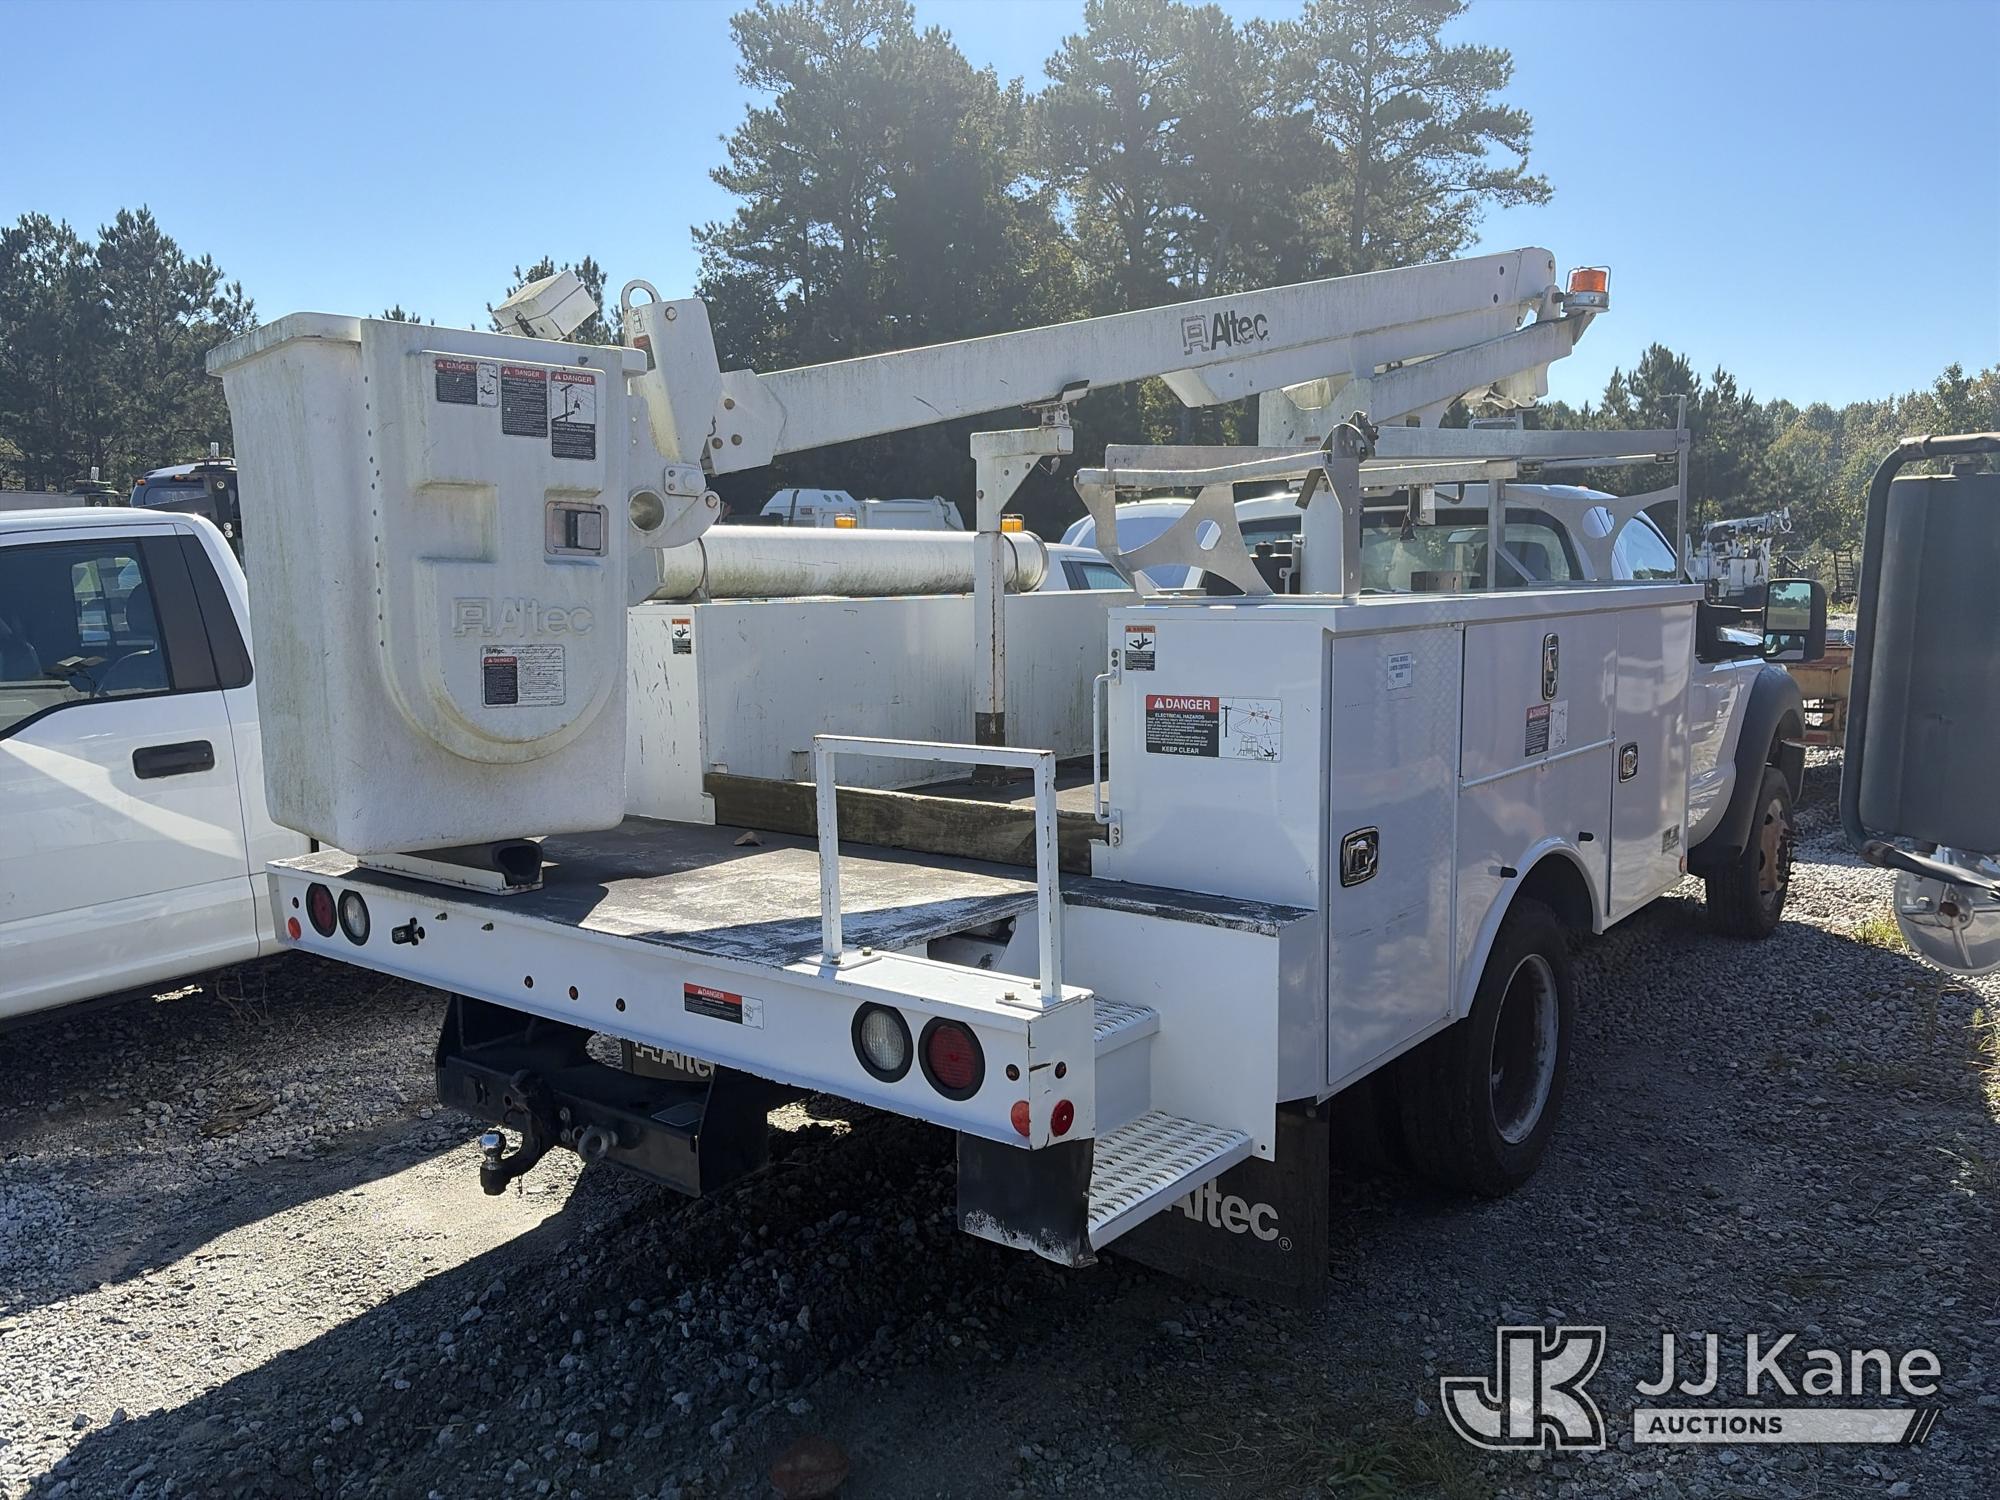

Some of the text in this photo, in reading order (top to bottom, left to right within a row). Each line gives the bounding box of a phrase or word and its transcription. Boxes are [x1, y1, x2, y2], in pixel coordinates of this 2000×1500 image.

[1210, 309, 1269, 351] Altec
[514, 369, 540, 377] DANGER
[562, 374, 592, 383] DANGER
[495, 597, 595, 637] Altec
[1165, 698, 1211, 711] DANGER
[1161, 745, 1178, 753] KEEP
[702, 988, 725, 999] DANGER
